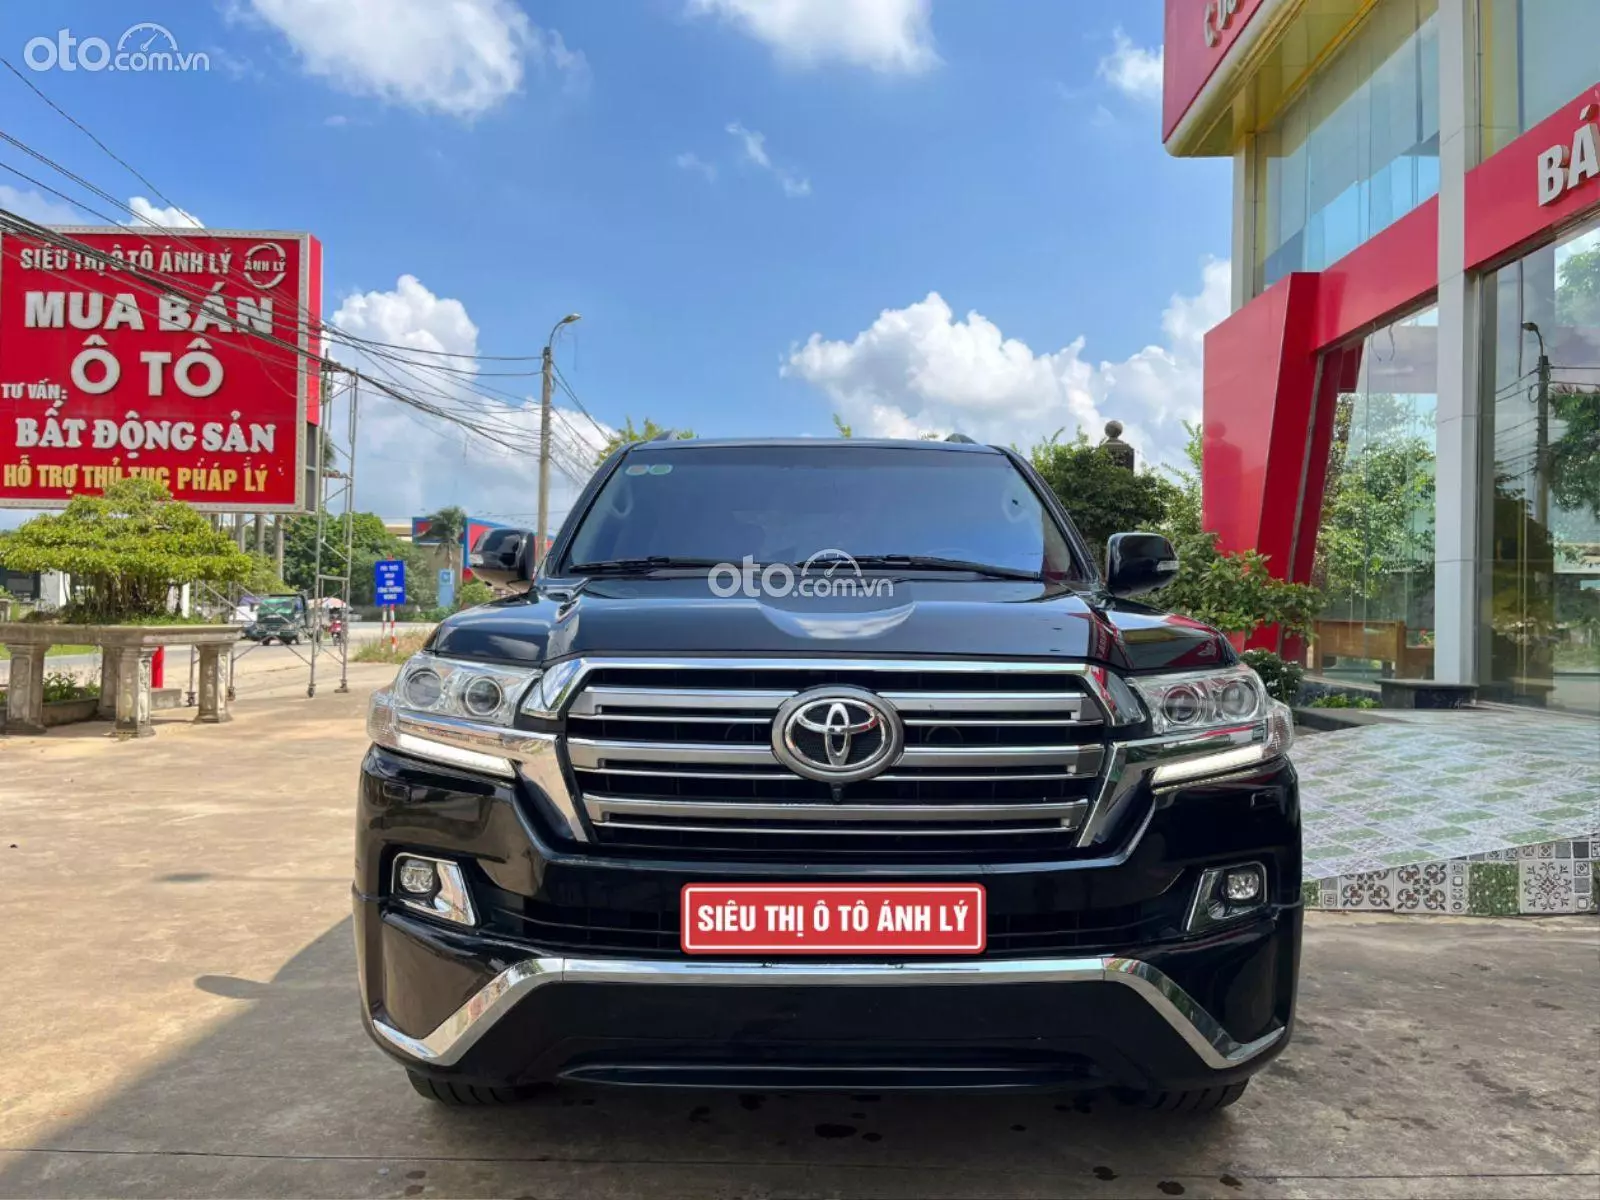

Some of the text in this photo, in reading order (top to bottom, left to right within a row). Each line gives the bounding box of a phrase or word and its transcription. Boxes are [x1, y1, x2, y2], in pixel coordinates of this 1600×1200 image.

[20, 243, 69, 270] SIÊU
[127, 244, 154, 272] TÔ
[159, 245, 204, 273] ÁNH
[208, 247, 232, 275] LÝ
[272, 258, 286, 272] LÝ
[24, 282, 273, 334] MUA BÁN
[71, 334, 224, 397] Ô TÔ
[1, 383, 25, 399] TƯ
[15, 400, 276, 459] BẤT ĐỘNG SẢN
[3, 454, 32, 488] HỖ
[37, 464, 78, 494] TRỢ
[82, 456, 123, 490] THỦ
[177, 462, 237, 491] PHÁP
[244, 463, 268, 492] LÝ
[698, 900, 969, 937] SIÊU THỊ Ô TÔ ÁNH LÝ
